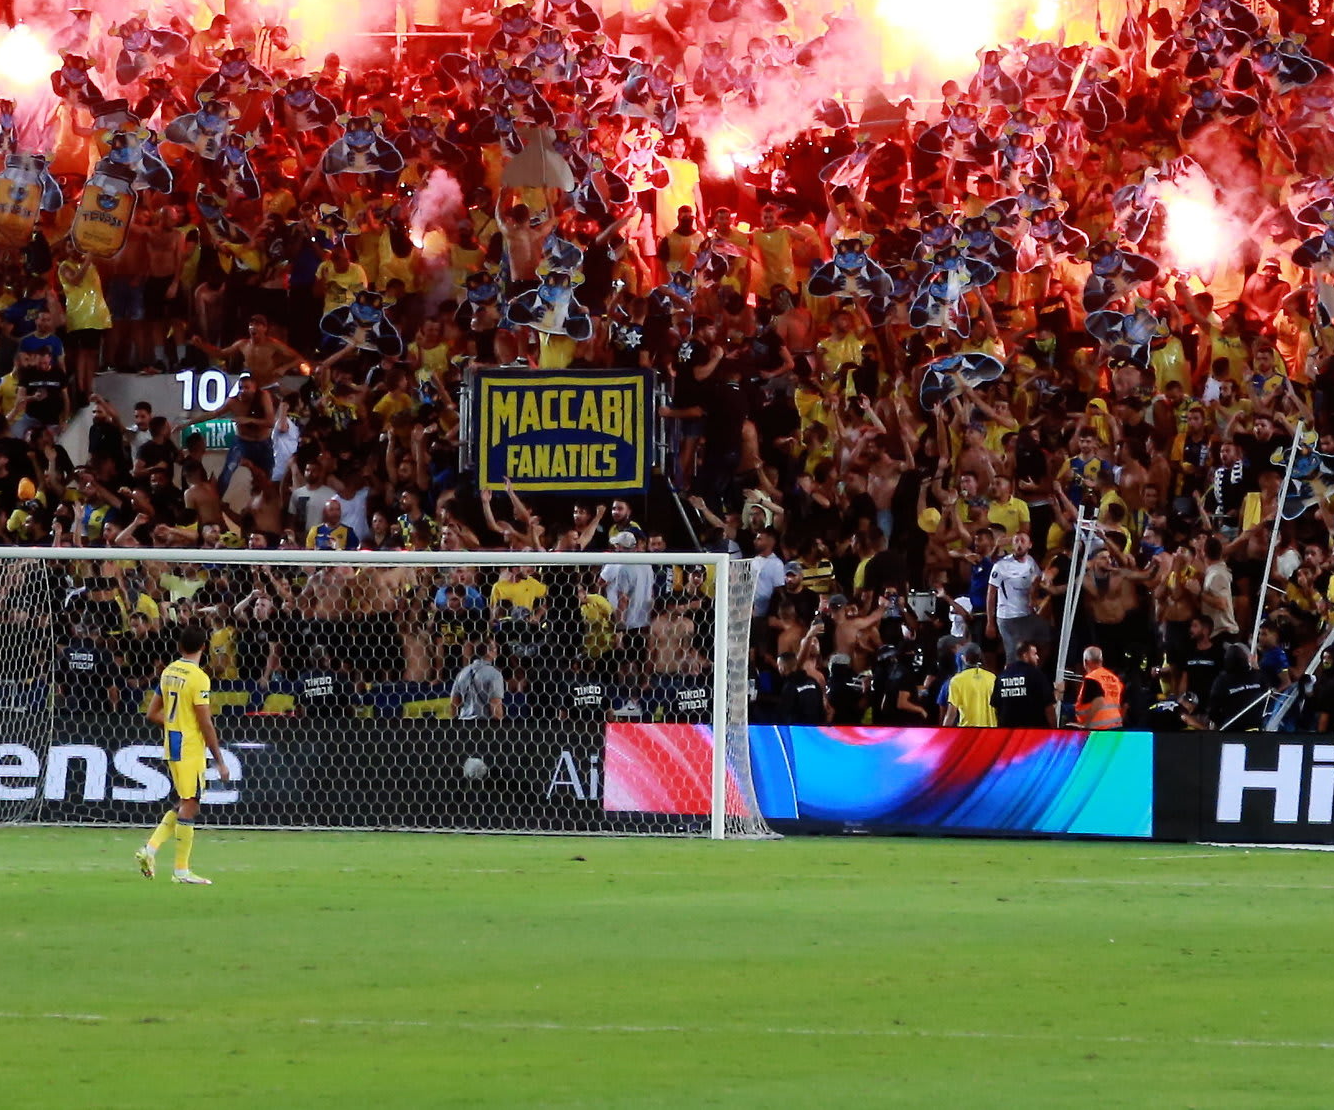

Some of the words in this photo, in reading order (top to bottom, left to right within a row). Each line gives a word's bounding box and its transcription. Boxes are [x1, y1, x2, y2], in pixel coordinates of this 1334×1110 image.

[492, 390, 633, 446] MACCABI
[507, 444, 617, 478] FANATICS
[168, 691, 179, 723] 7
[546, 751, 598, 800] Ai
